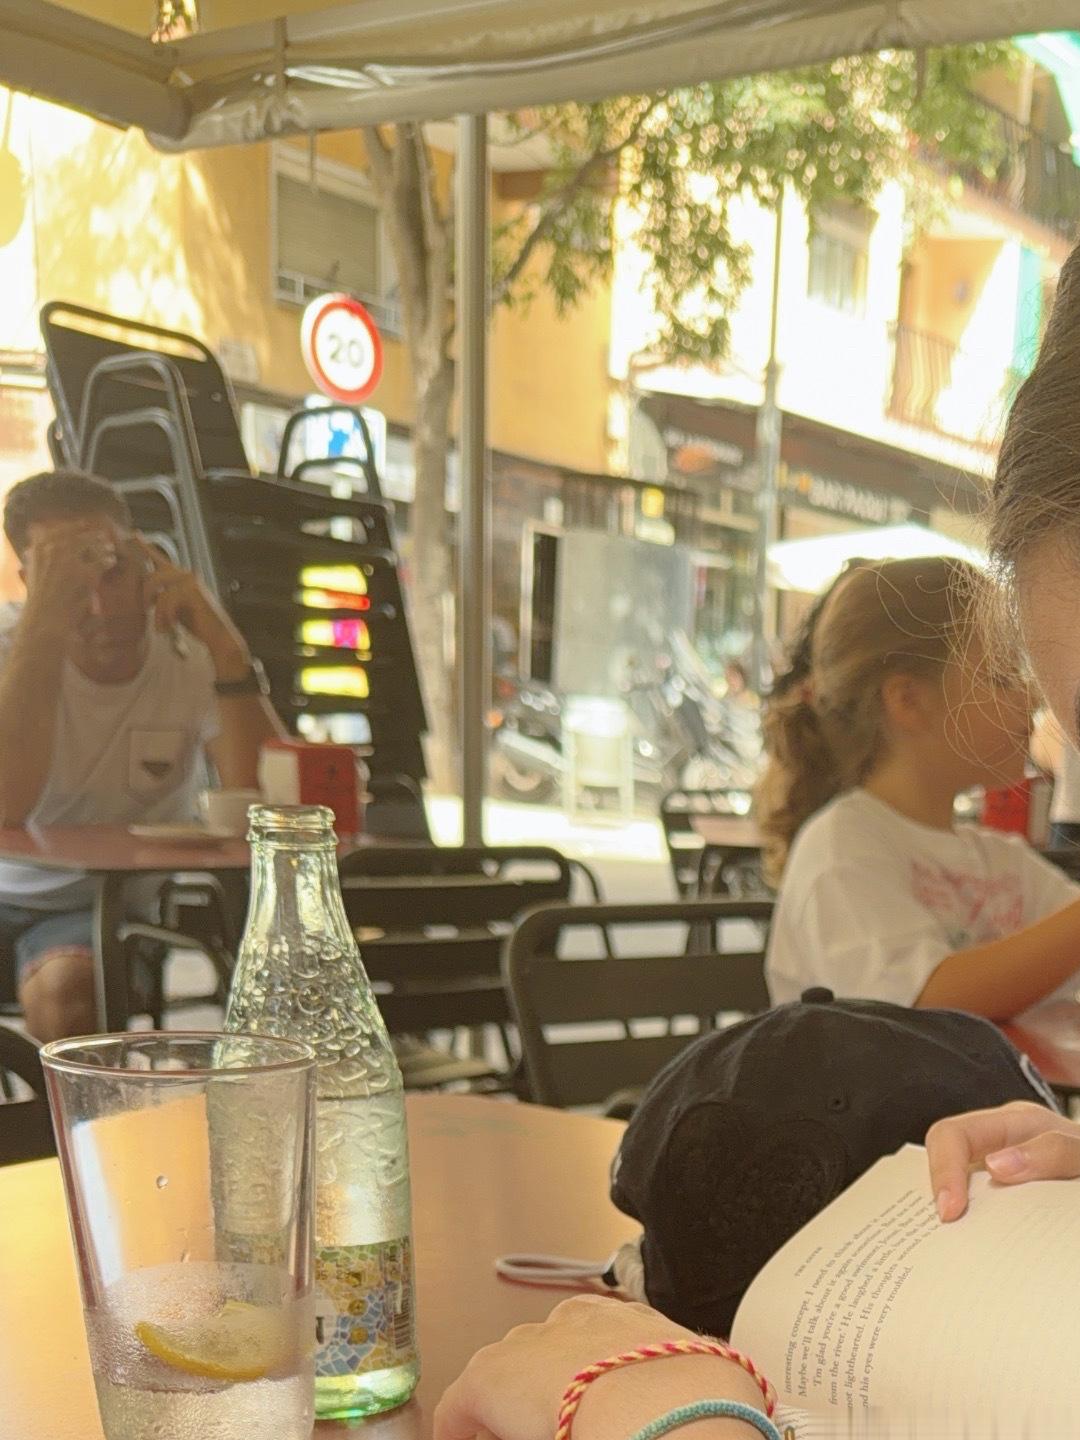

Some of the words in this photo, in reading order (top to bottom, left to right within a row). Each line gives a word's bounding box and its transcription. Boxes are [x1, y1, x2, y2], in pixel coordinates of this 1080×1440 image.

[328, 333, 364, 368] 20
[849, 1275, 874, 1308] laughed
[887, 1265, 914, 1302] troubled.
[815, 1287, 832, 1313] about
[808, 1315, 819, 1334] talk
[816, 1342, 827, 1366] glad
[822, 1311, 837, 1341] you're
[838, 1279, 854, 1301] good
[840, 1311, 854, 1327] He
[845, 1324, 866, 1389] lighthearted.
[860, 1302, 874, 1320] His
[871, 1263, 898, 1299] thoughts
[878, 1305, 892, 1324] very
[784, 1341, 797, 1393] interesting
[791, 1299, 811, 1338] concept.
[802, 1336, 813, 1363] we'll
[869, 1326, 881, 1350] were
[830, 1361, 839, 1379] the
[864, 1353, 874, 1375] eyes
[798, 1363, 809, 1397] Maybe
[829, 1380, 838, 1405] from
[860, 1376, 870, 1393] his
